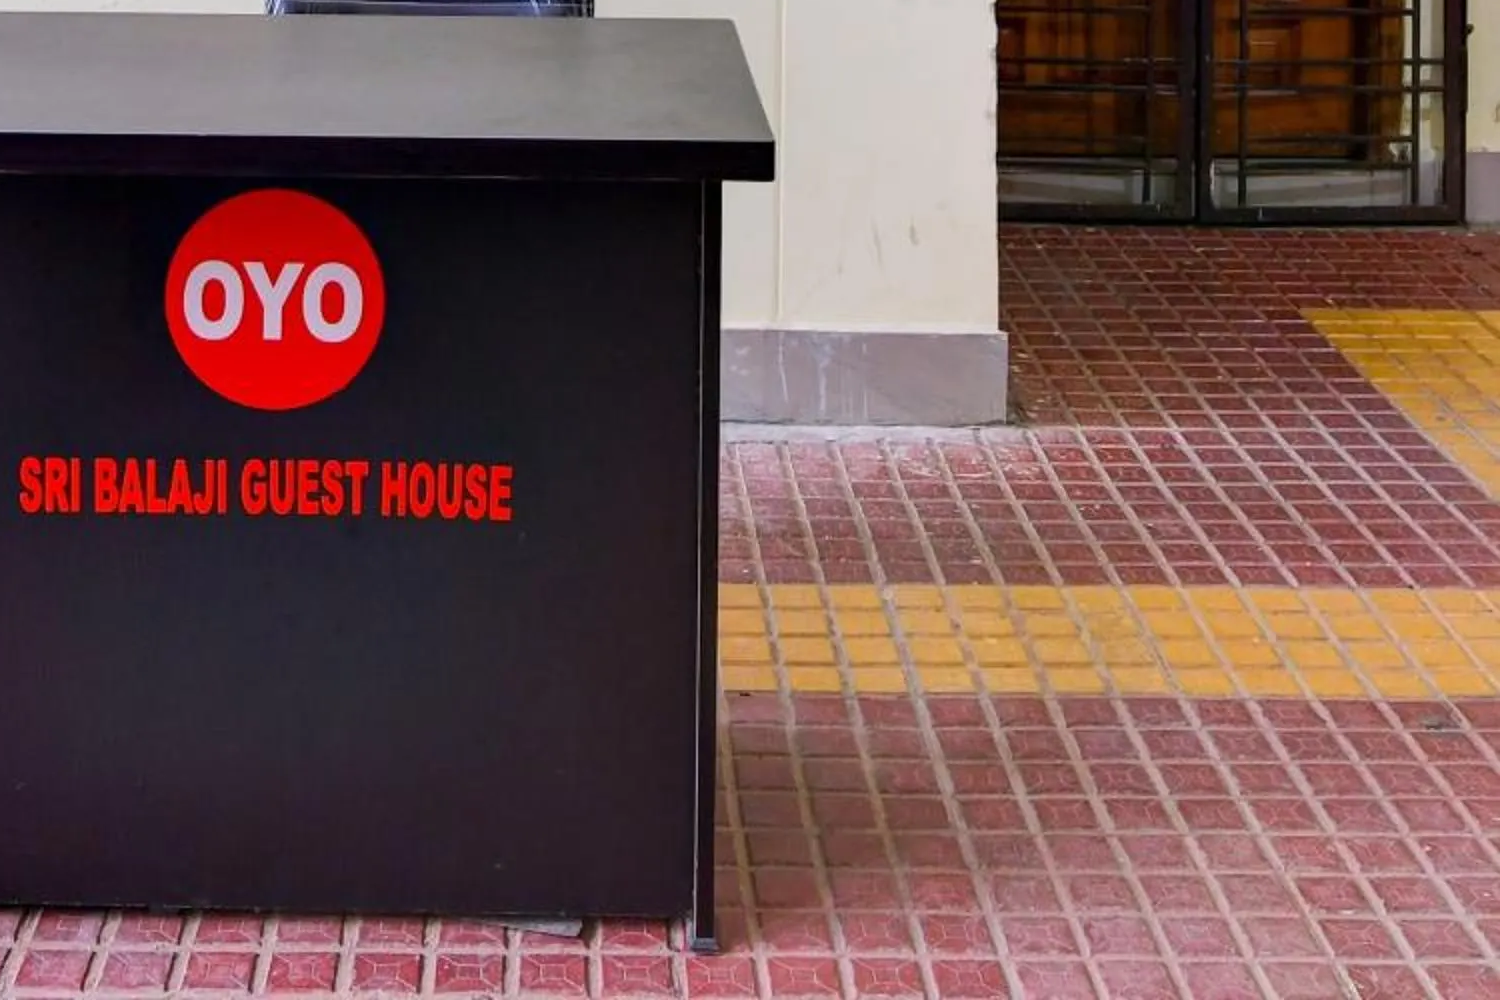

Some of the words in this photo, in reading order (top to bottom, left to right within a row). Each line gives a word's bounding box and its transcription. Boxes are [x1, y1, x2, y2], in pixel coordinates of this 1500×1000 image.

[183, 259, 363, 343] OYO
[19, 456, 81, 513] SRI
[93, 457, 228, 514] BALAJI
[240, 458, 370, 517] GUEST
[380, 461, 513, 521] HOUSE
